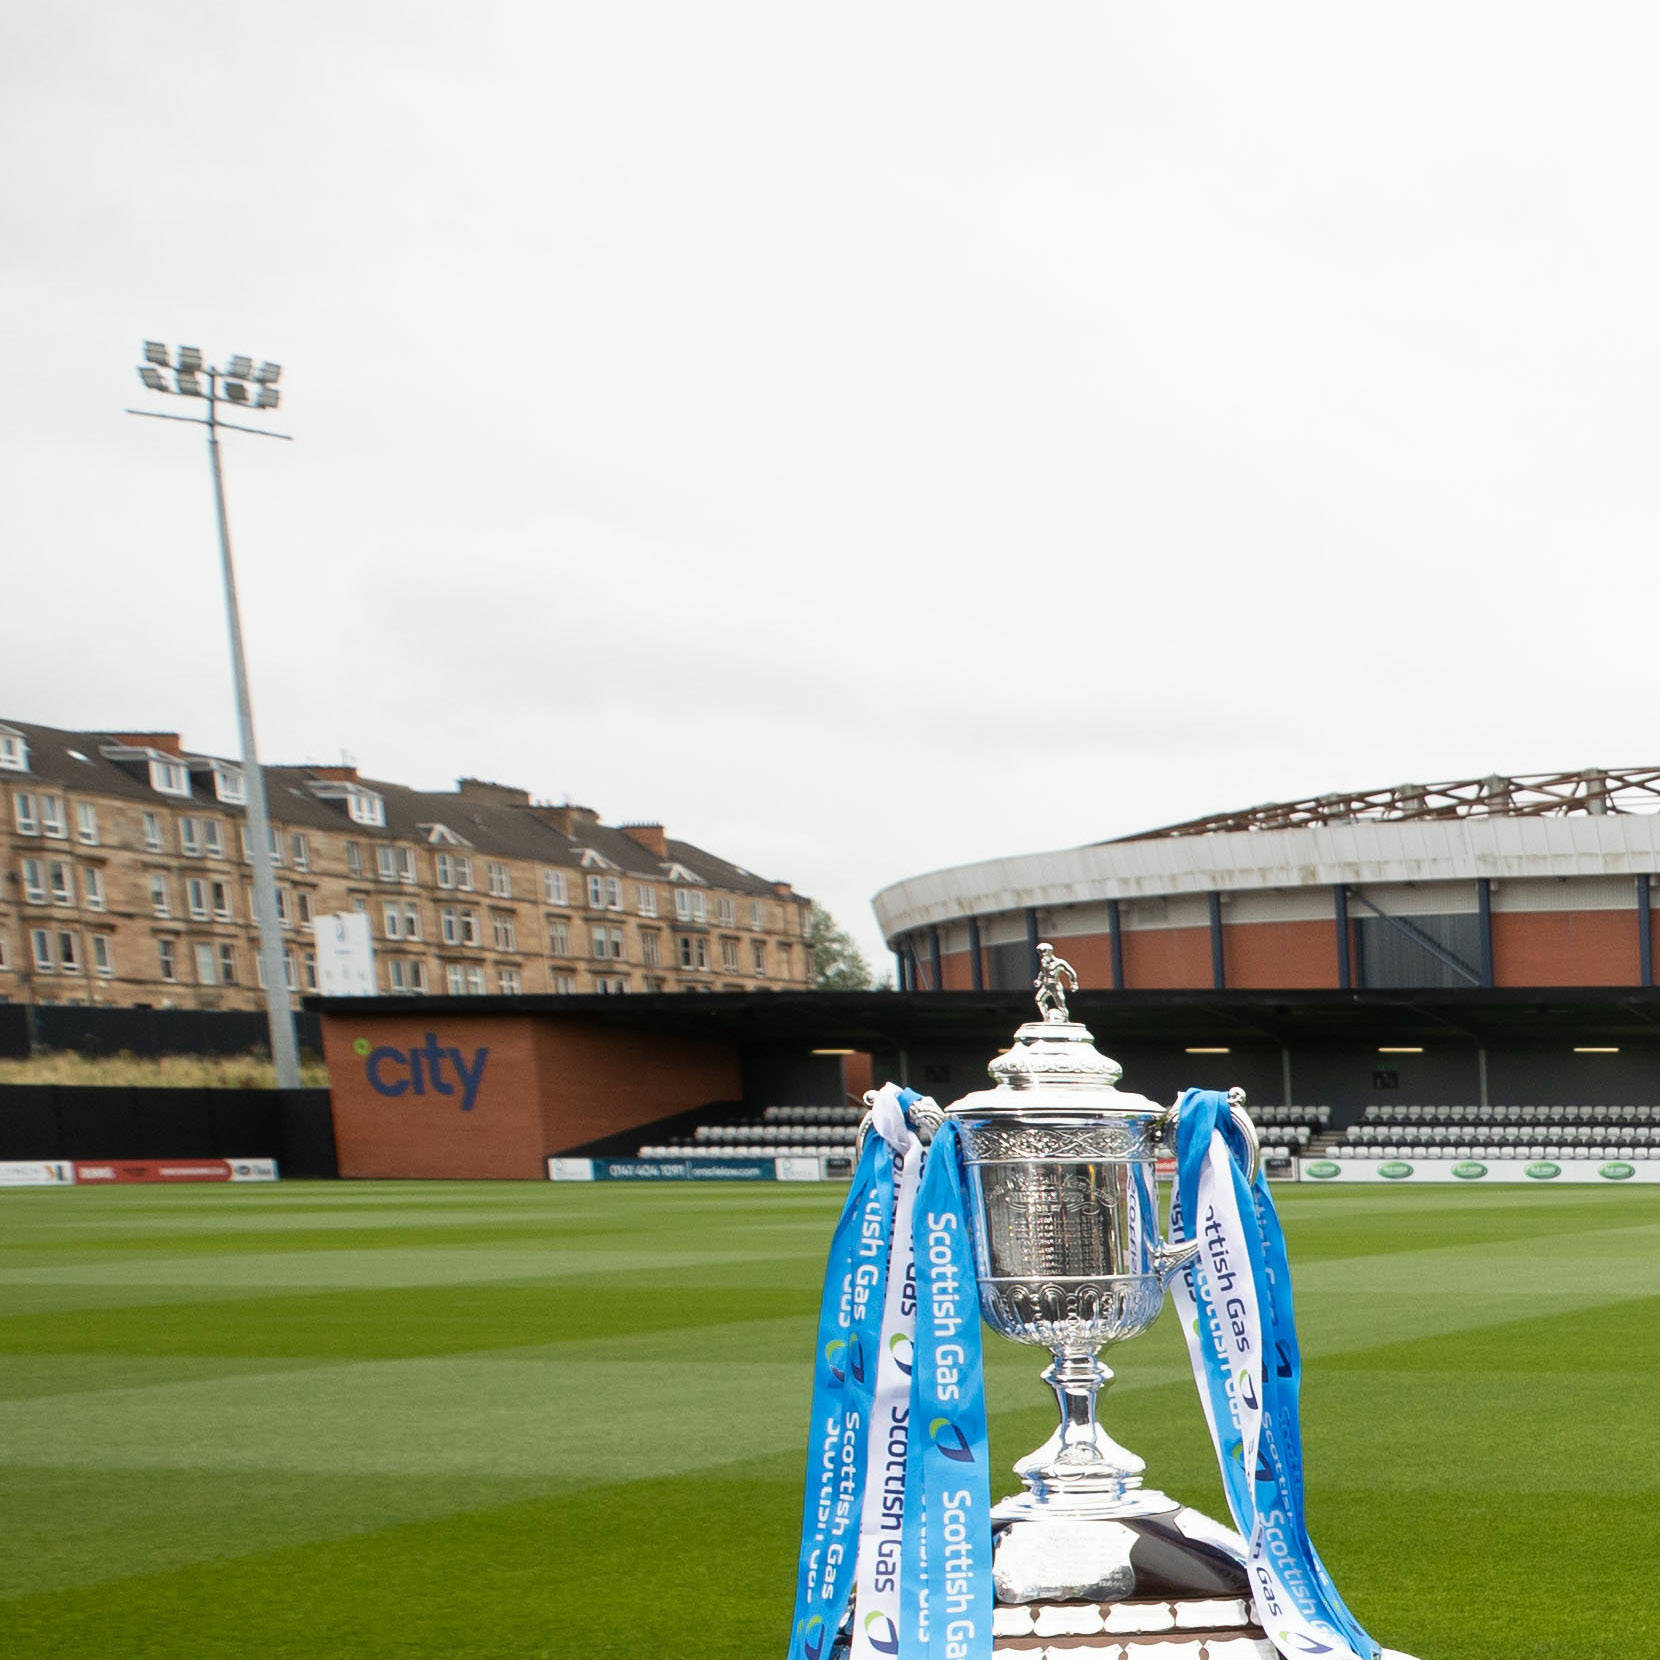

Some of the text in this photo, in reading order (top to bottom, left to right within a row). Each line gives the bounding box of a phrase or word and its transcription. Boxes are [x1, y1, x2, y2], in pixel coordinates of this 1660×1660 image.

[366, 1032, 489, 1111] city
[854, 1264, 878, 1320] Gas
[927, 1212, 964, 1402] Scottish Gas
[1226, 1298, 1250, 1353] Gas
[831, 1411, 860, 1537] Scottish
[821, 1542, 845, 1600] Gas
[875, 1540, 902, 1594] Gas
[943, 1490, 975, 1614] Scottish
[1260, 1509, 1317, 1621] Scottish
[1256, 1566, 1283, 1617] Gas
